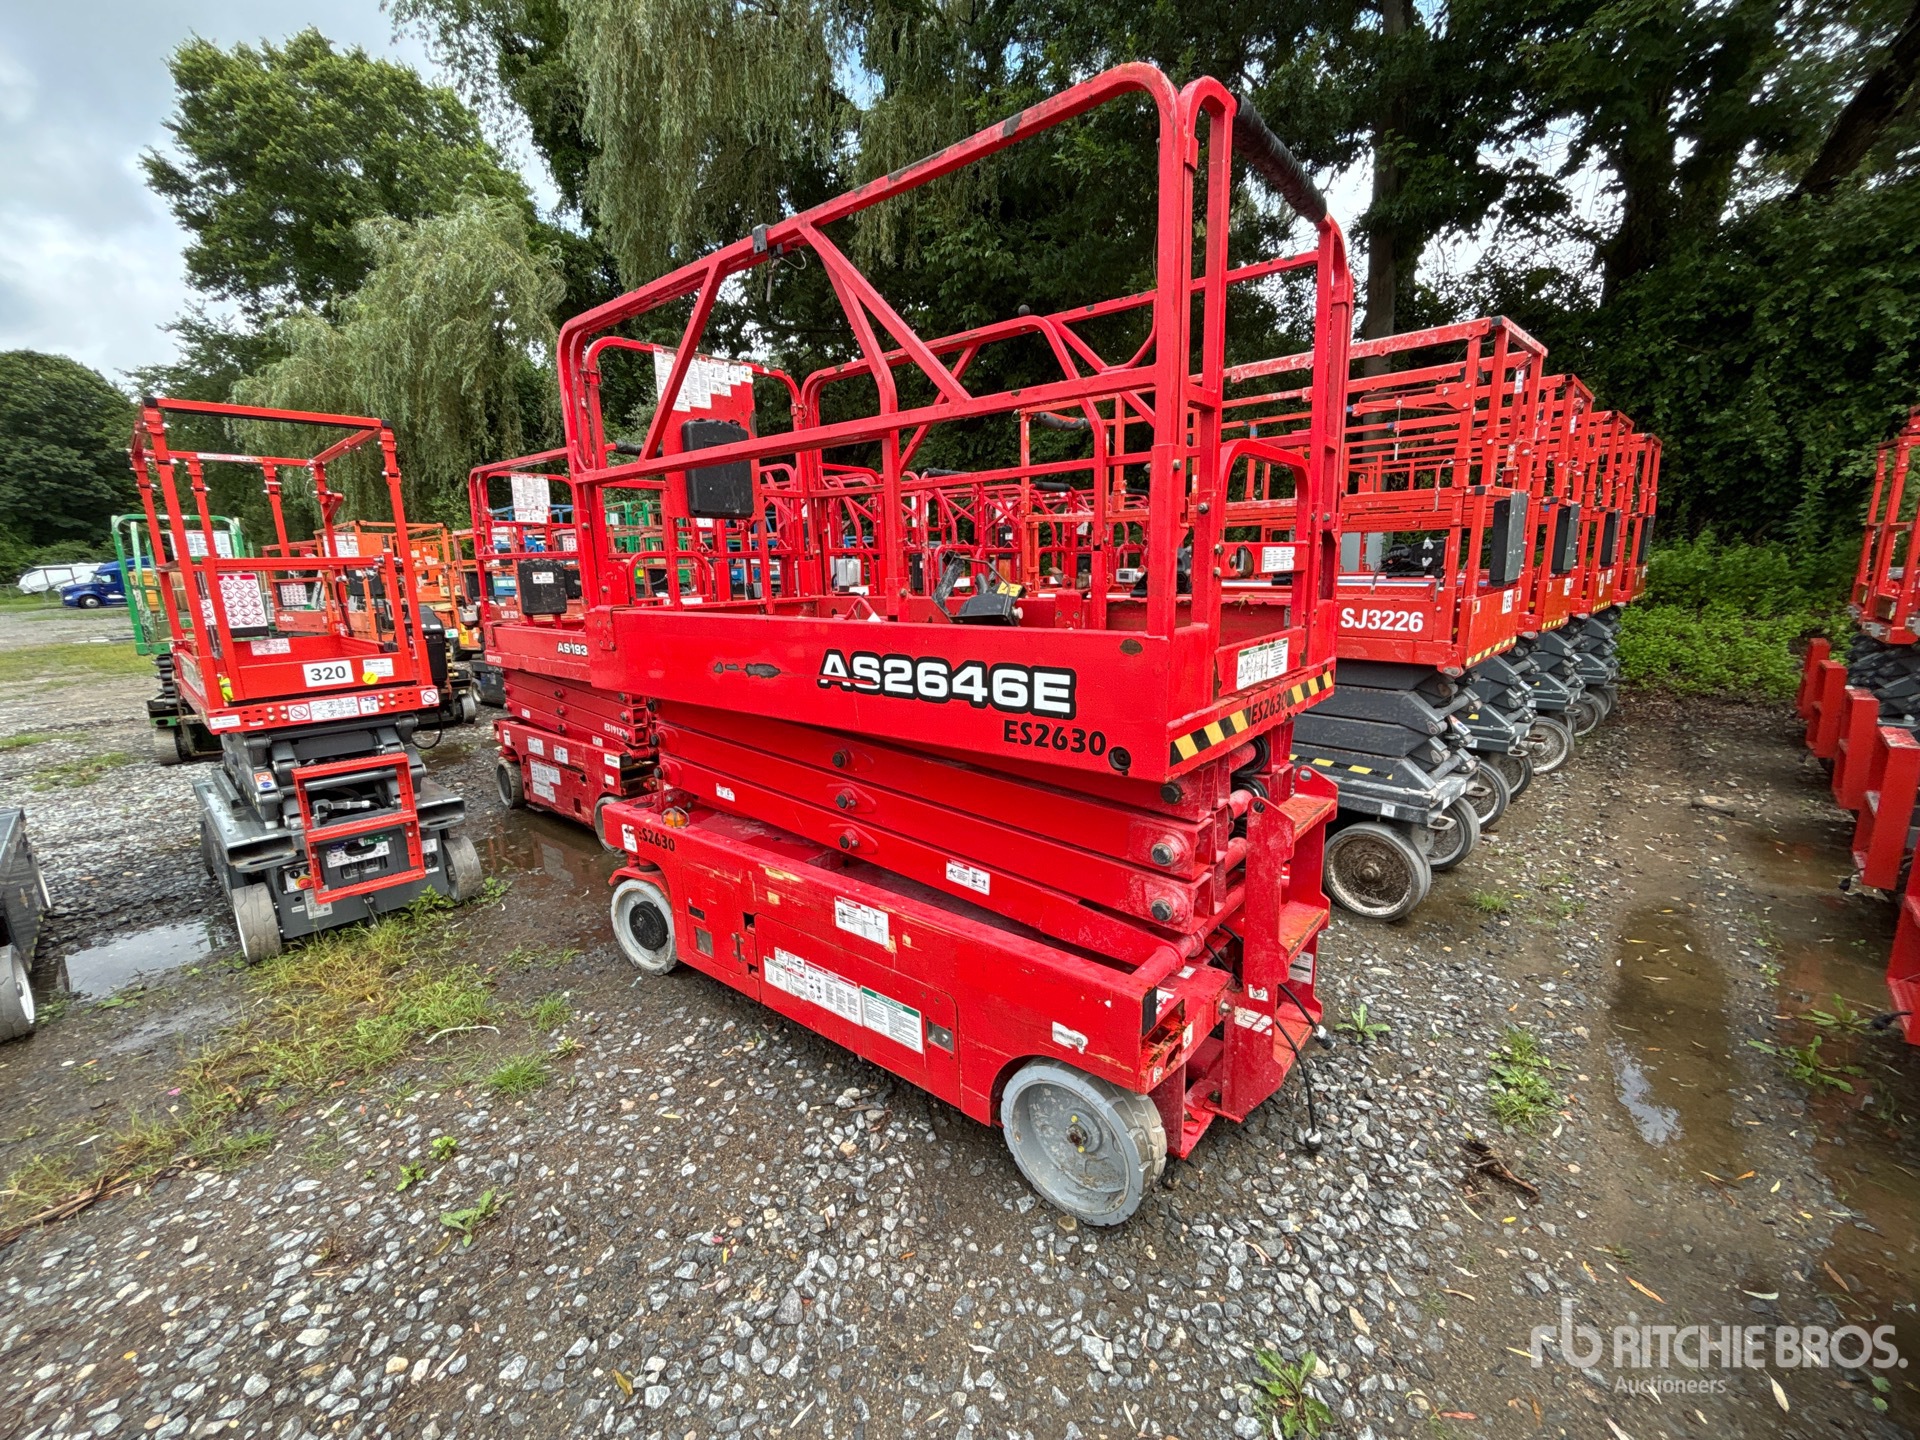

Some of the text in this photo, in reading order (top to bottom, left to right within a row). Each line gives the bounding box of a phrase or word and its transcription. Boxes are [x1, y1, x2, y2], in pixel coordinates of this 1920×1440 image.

[1340, 607, 1424, 632] SJ3226
[310, 665, 347, 682] 320
[818, 650, 1076, 718] AS2646E
[1251, 690, 1288, 726] ES2630
[1003, 719, 1107, 756] ES2630
